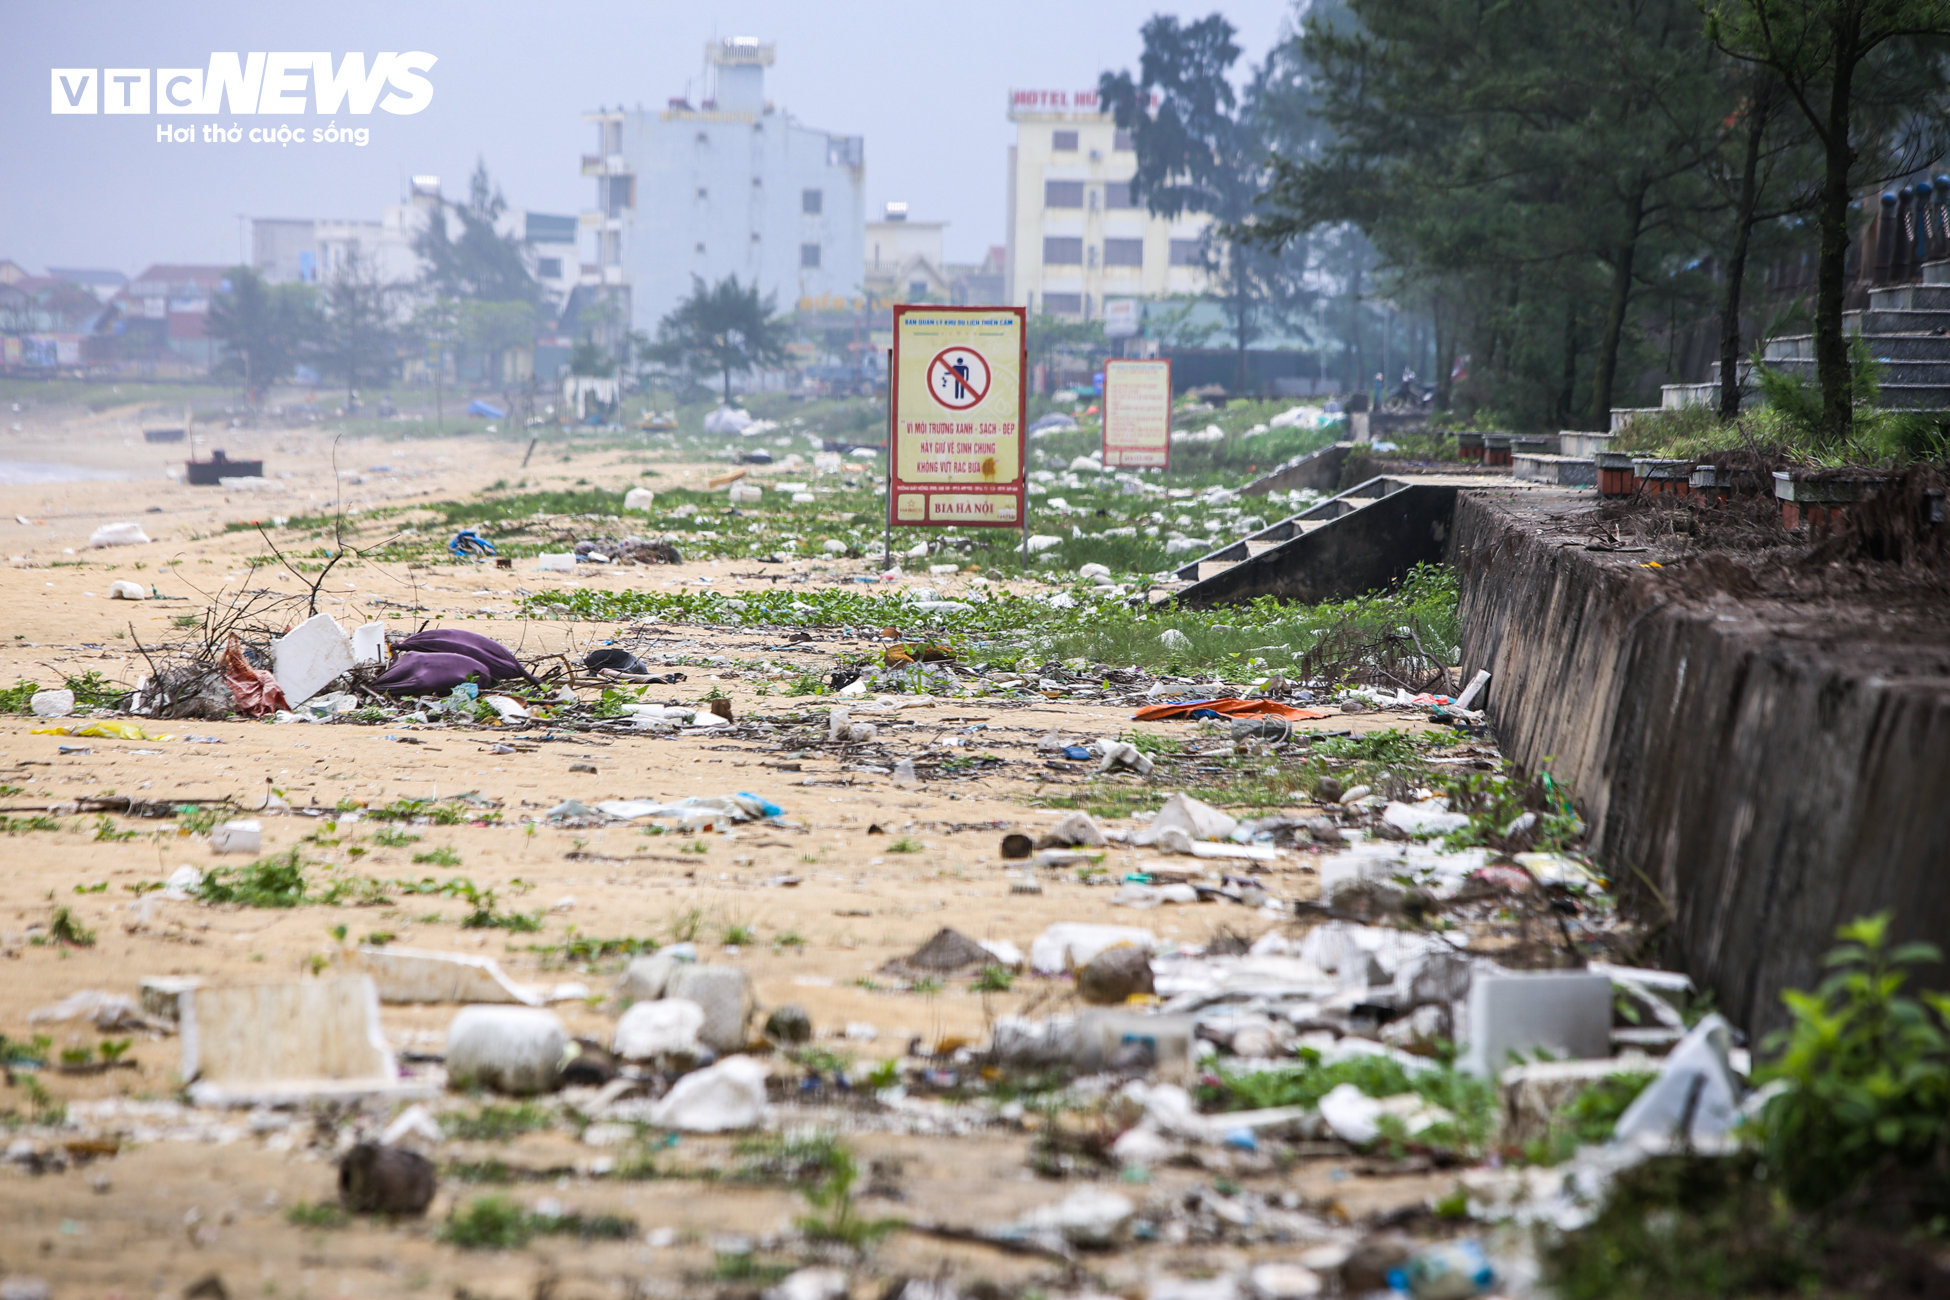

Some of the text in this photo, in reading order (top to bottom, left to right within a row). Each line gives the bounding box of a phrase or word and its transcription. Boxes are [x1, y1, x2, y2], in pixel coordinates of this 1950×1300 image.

[1014, 91, 1067, 106] HOTEL
[915, 421, 927, 434] MÔI
[929, 420, 954, 434] TRƯỜNG
[956, 423, 973, 434] XANH
[979, 423, 996, 438] SẠCH
[1003, 422, 1015, 438] ĐẸP
[957, 442, 972, 454] SINH
[974, 443, 996, 454] CHUNG
[917, 460, 938, 473] KHÔNG
[935, 500, 994, 516] BIA HÀ NỘI
